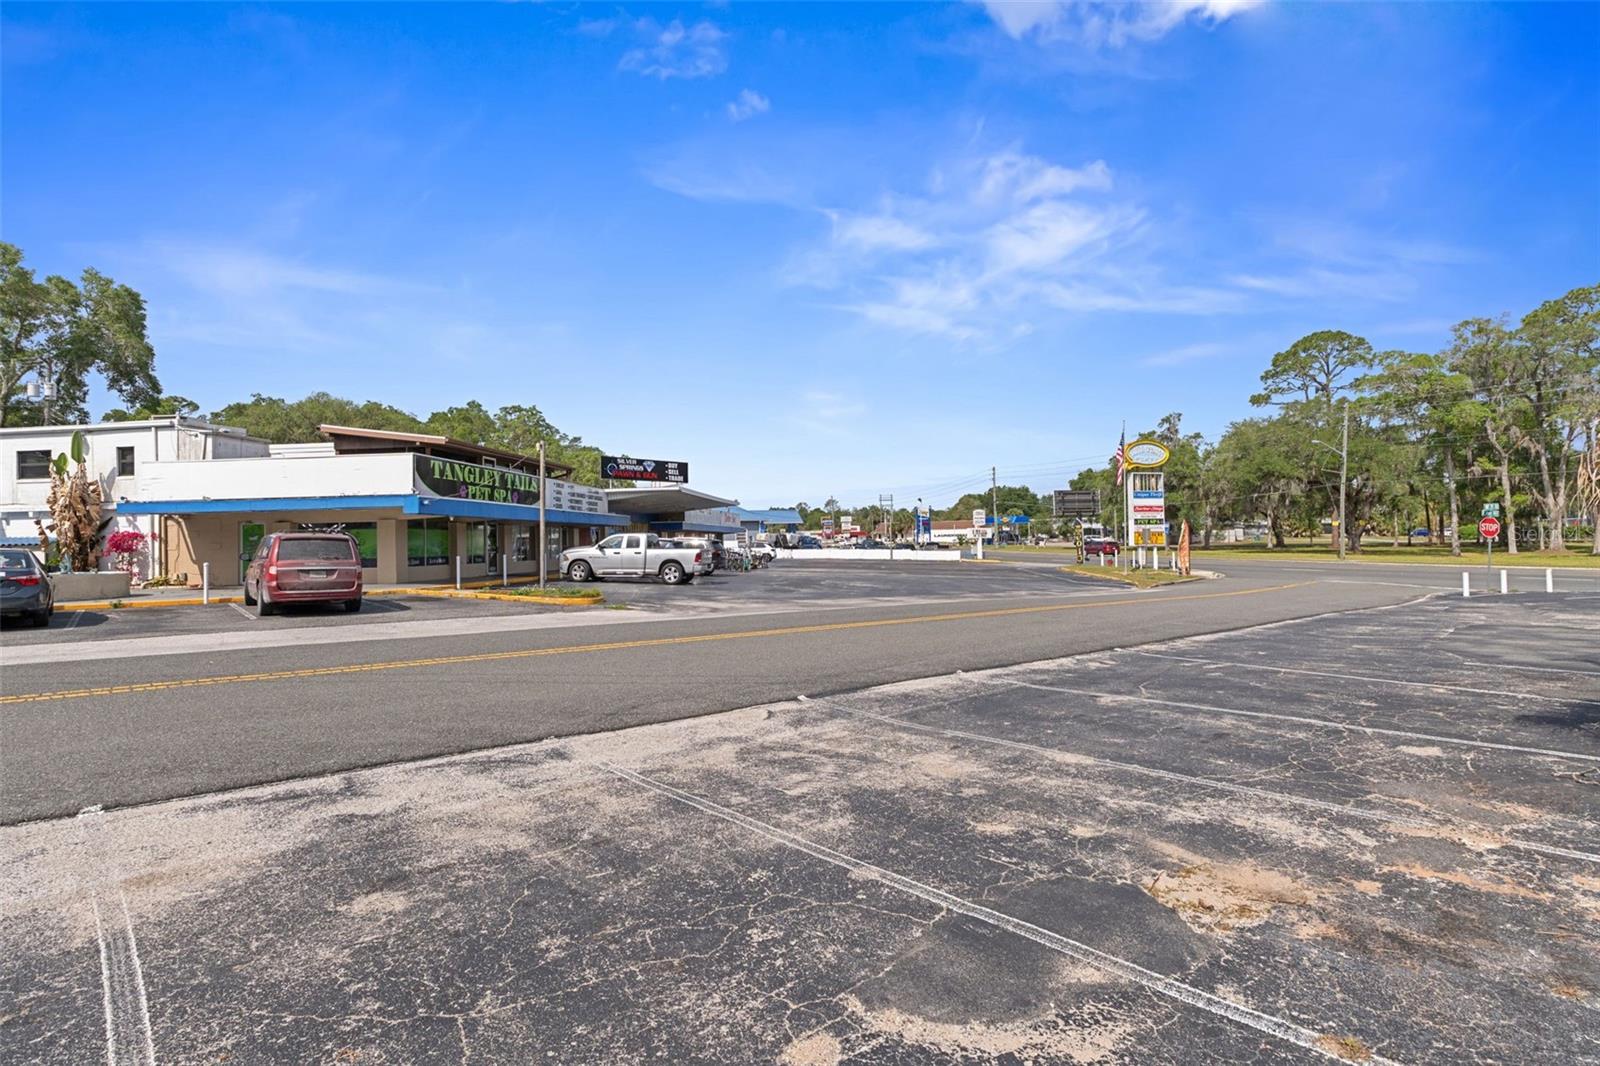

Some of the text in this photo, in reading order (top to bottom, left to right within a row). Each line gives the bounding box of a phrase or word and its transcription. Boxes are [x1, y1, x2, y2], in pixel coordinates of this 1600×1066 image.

[431, 460, 539, 493] TANGLEY TAILS
[468, 485, 512, 503] PET SPA
[1481, 523, 1498, 531] STOP
